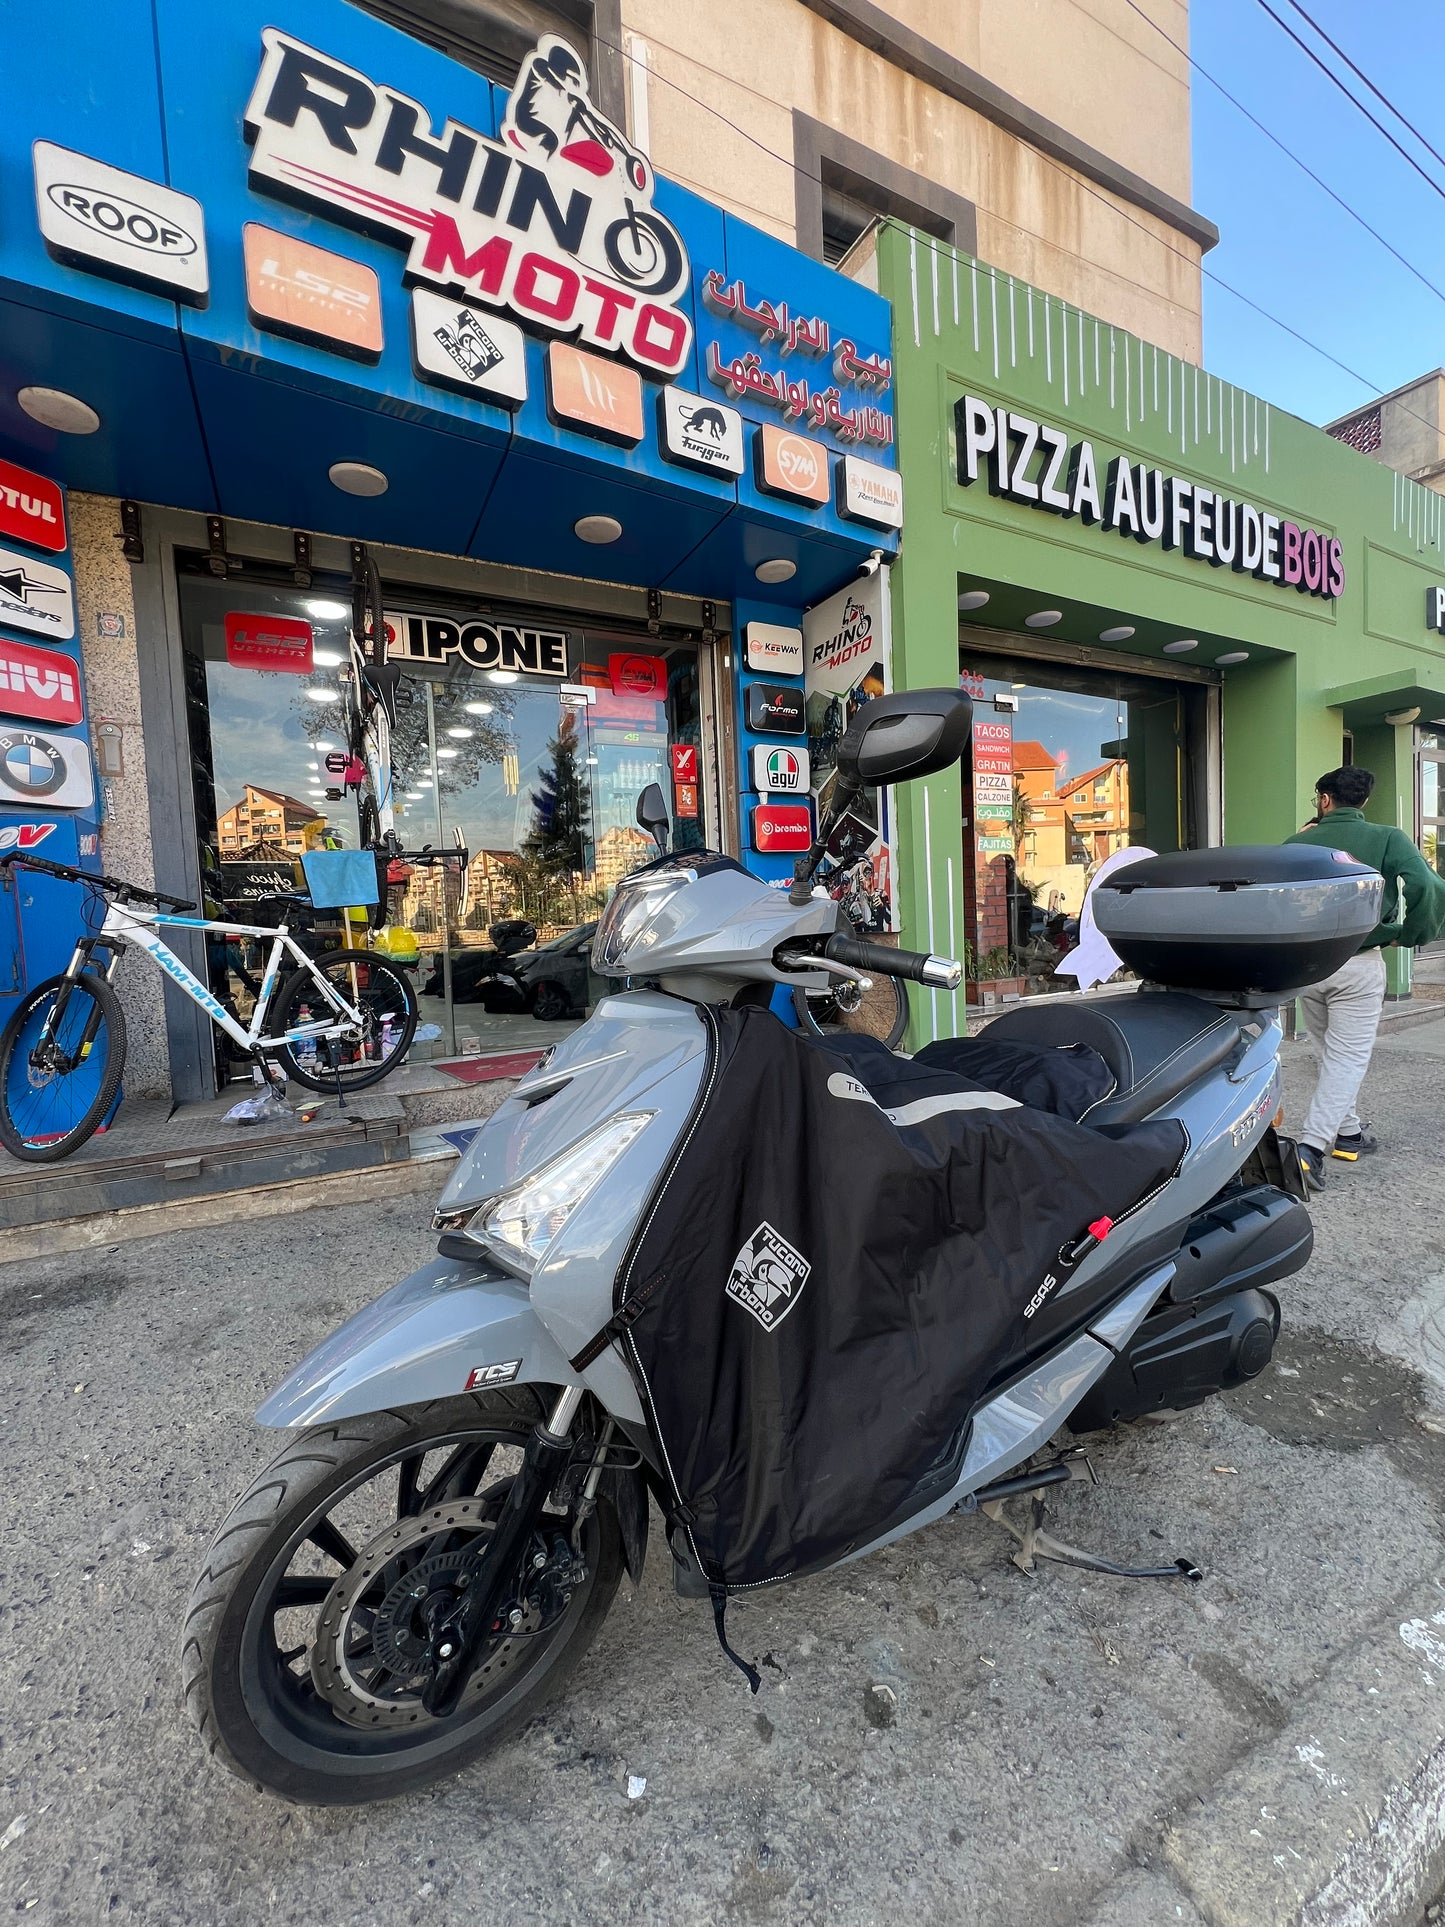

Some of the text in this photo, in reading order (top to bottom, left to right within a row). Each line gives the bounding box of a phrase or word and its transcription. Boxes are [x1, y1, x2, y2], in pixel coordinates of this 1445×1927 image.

[264, 40, 683, 296] RHINO
[63, 190, 184, 247] ROOF
[259, 259, 371, 310] LS2
[421, 209, 688, 367] MOTO
[708, 269, 892, 389] بيع الدراجات
[828, 387, 893, 443] النارية
[780, 449, 817, 480] SYM
[0, 485, 57, 524] TUL
[861, 478, 899, 505] YAMAHA
[964, 394, 1346, 599] PIZZA AU FEU DE BOIS
[234, 630, 308, 650] LS2
[407, 616, 566, 675] IPONE
[812, 614, 872, 664] RHINO
[829, 635, 873, 670] MOTO
[0, 735, 60, 759] BMW
[975, 725, 1010, 739] TACOS
[976, 744, 1010, 754] SANDWICH
[977, 759, 1011, 771] GRATIN
[977, 793, 1011, 802] CALZONE
[979, 776, 1007, 788] PIZZA
[775, 823, 808, 834] brembo
[977, 807, 1011, 819] مقلوب
[978, 838, 1012, 850] FAJITAS
[1024, 1273, 1057, 1319] SGAS
[474, 1361, 518, 1382] TCS
